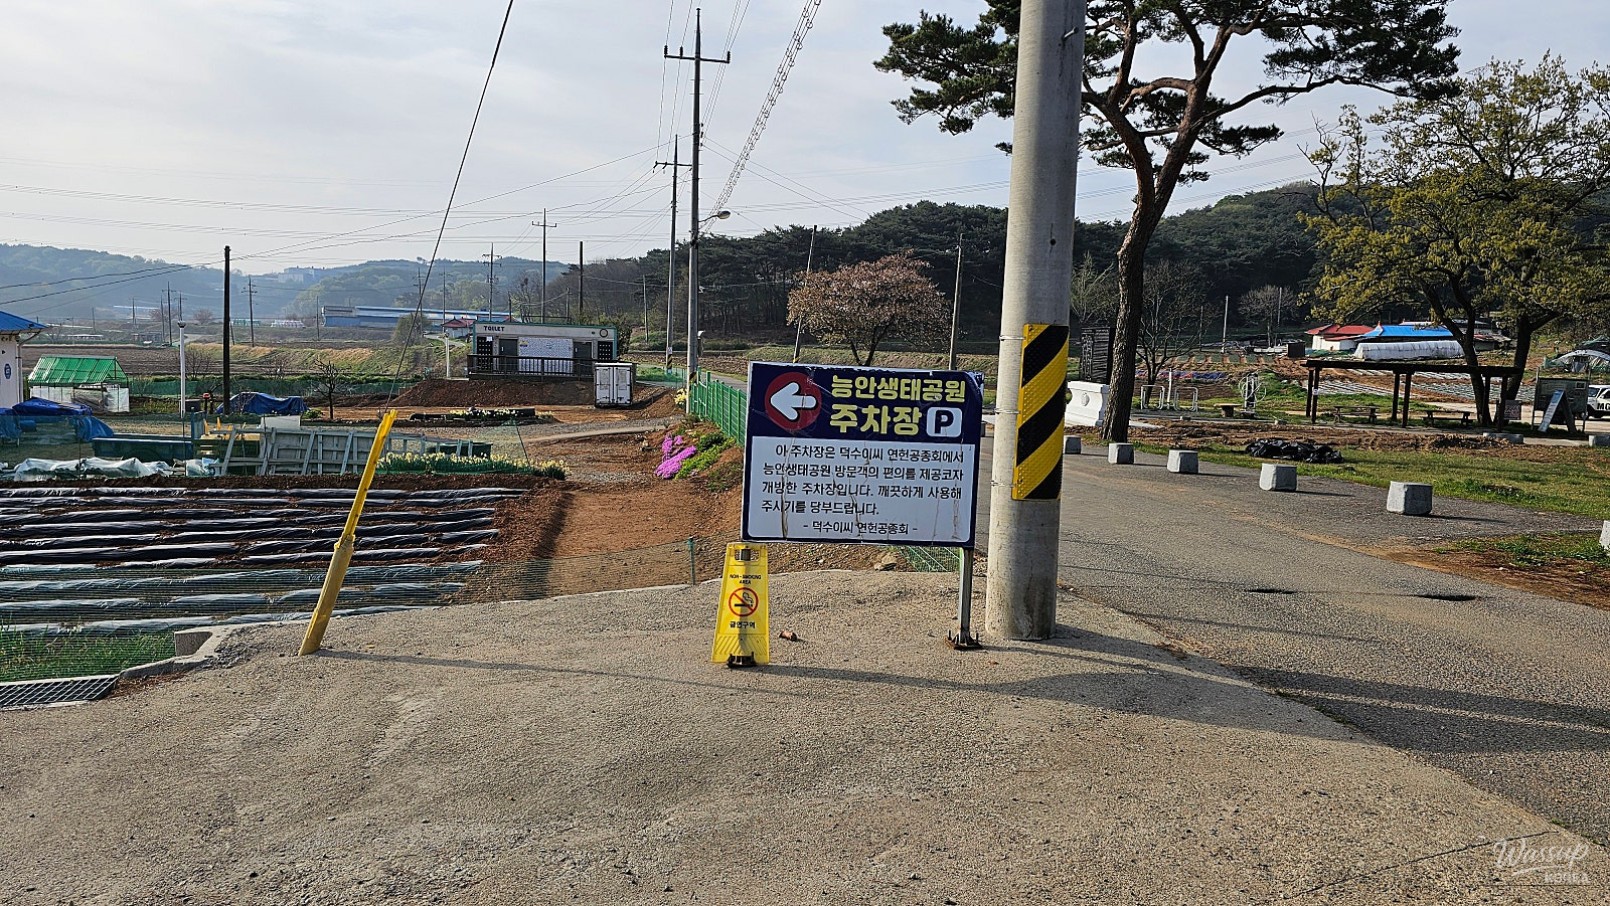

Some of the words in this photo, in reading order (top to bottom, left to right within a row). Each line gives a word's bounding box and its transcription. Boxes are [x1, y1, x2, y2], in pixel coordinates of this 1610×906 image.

[831, 375, 966, 403] 능안생태공원
[830, 403, 923, 436] 주차장
[934, 409, 955, 434] P
[790, 444, 836, 459] 주차장은
[839, 446, 883, 461] 덕수이씨
[887, 448, 964, 463] 연헌공종회에서
[763, 462, 831, 478] 능안생태공원
[834, 464, 879, 480] 방문객의
[883, 466, 917, 481] 편의를
[919, 468, 963, 482] 제공코자
[762, 481, 798, 495] 개방한
[801, 482, 874, 497] 주차장입니다.
[877, 485, 924, 499] 깨끗하게
[927, 486, 962, 500] 사용해
[810, 501, 880, 516] 당부드립니다.
[812, 521, 854, 534] 덕수이씨
